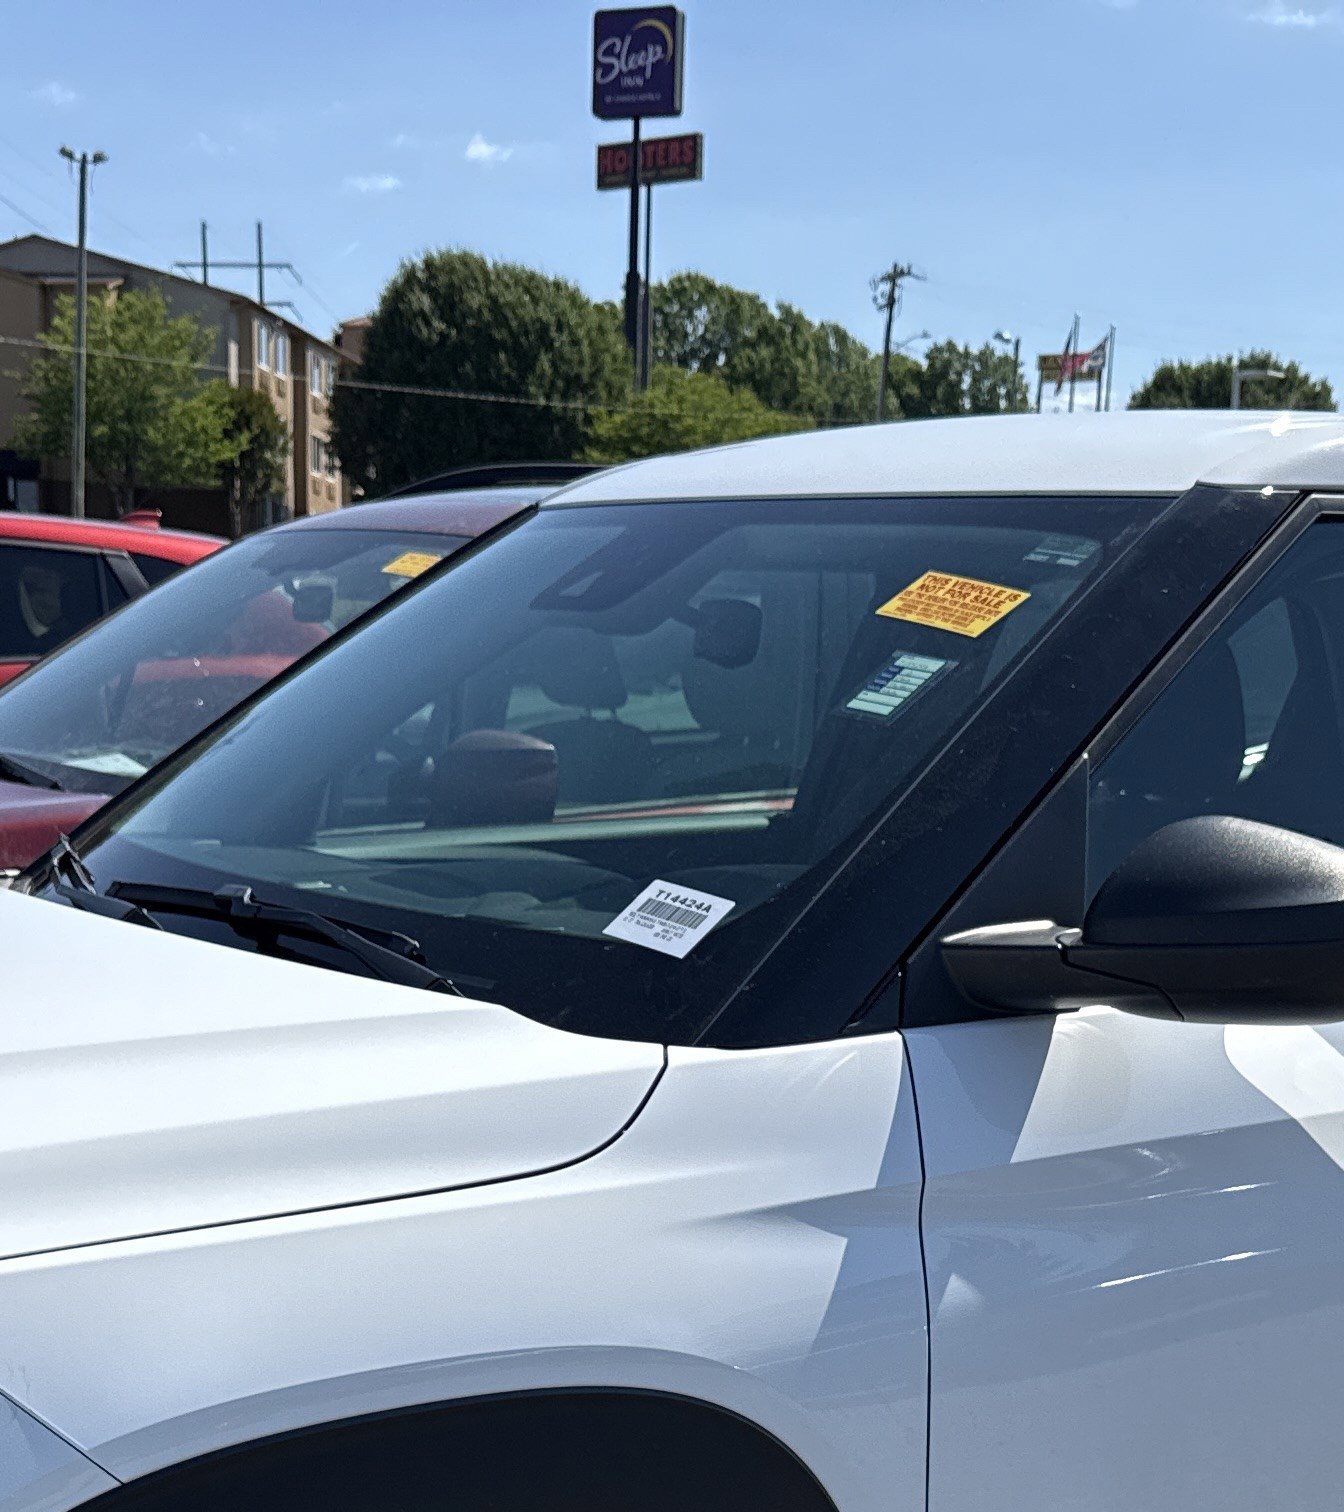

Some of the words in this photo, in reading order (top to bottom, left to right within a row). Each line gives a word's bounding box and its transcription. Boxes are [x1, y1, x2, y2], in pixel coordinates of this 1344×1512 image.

[595, 34, 665, 84] Sleep
[917, 584, 945, 595] NOT
[945, 589, 971, 602] FOR
[969, 594, 1006, 610] SALE
[922, 575, 953, 587] THIS
[952, 579, 1007, 599] VEHICLE
[1004, 592, 1022, 603] IS
[655, 889, 713, 914] T14424A
